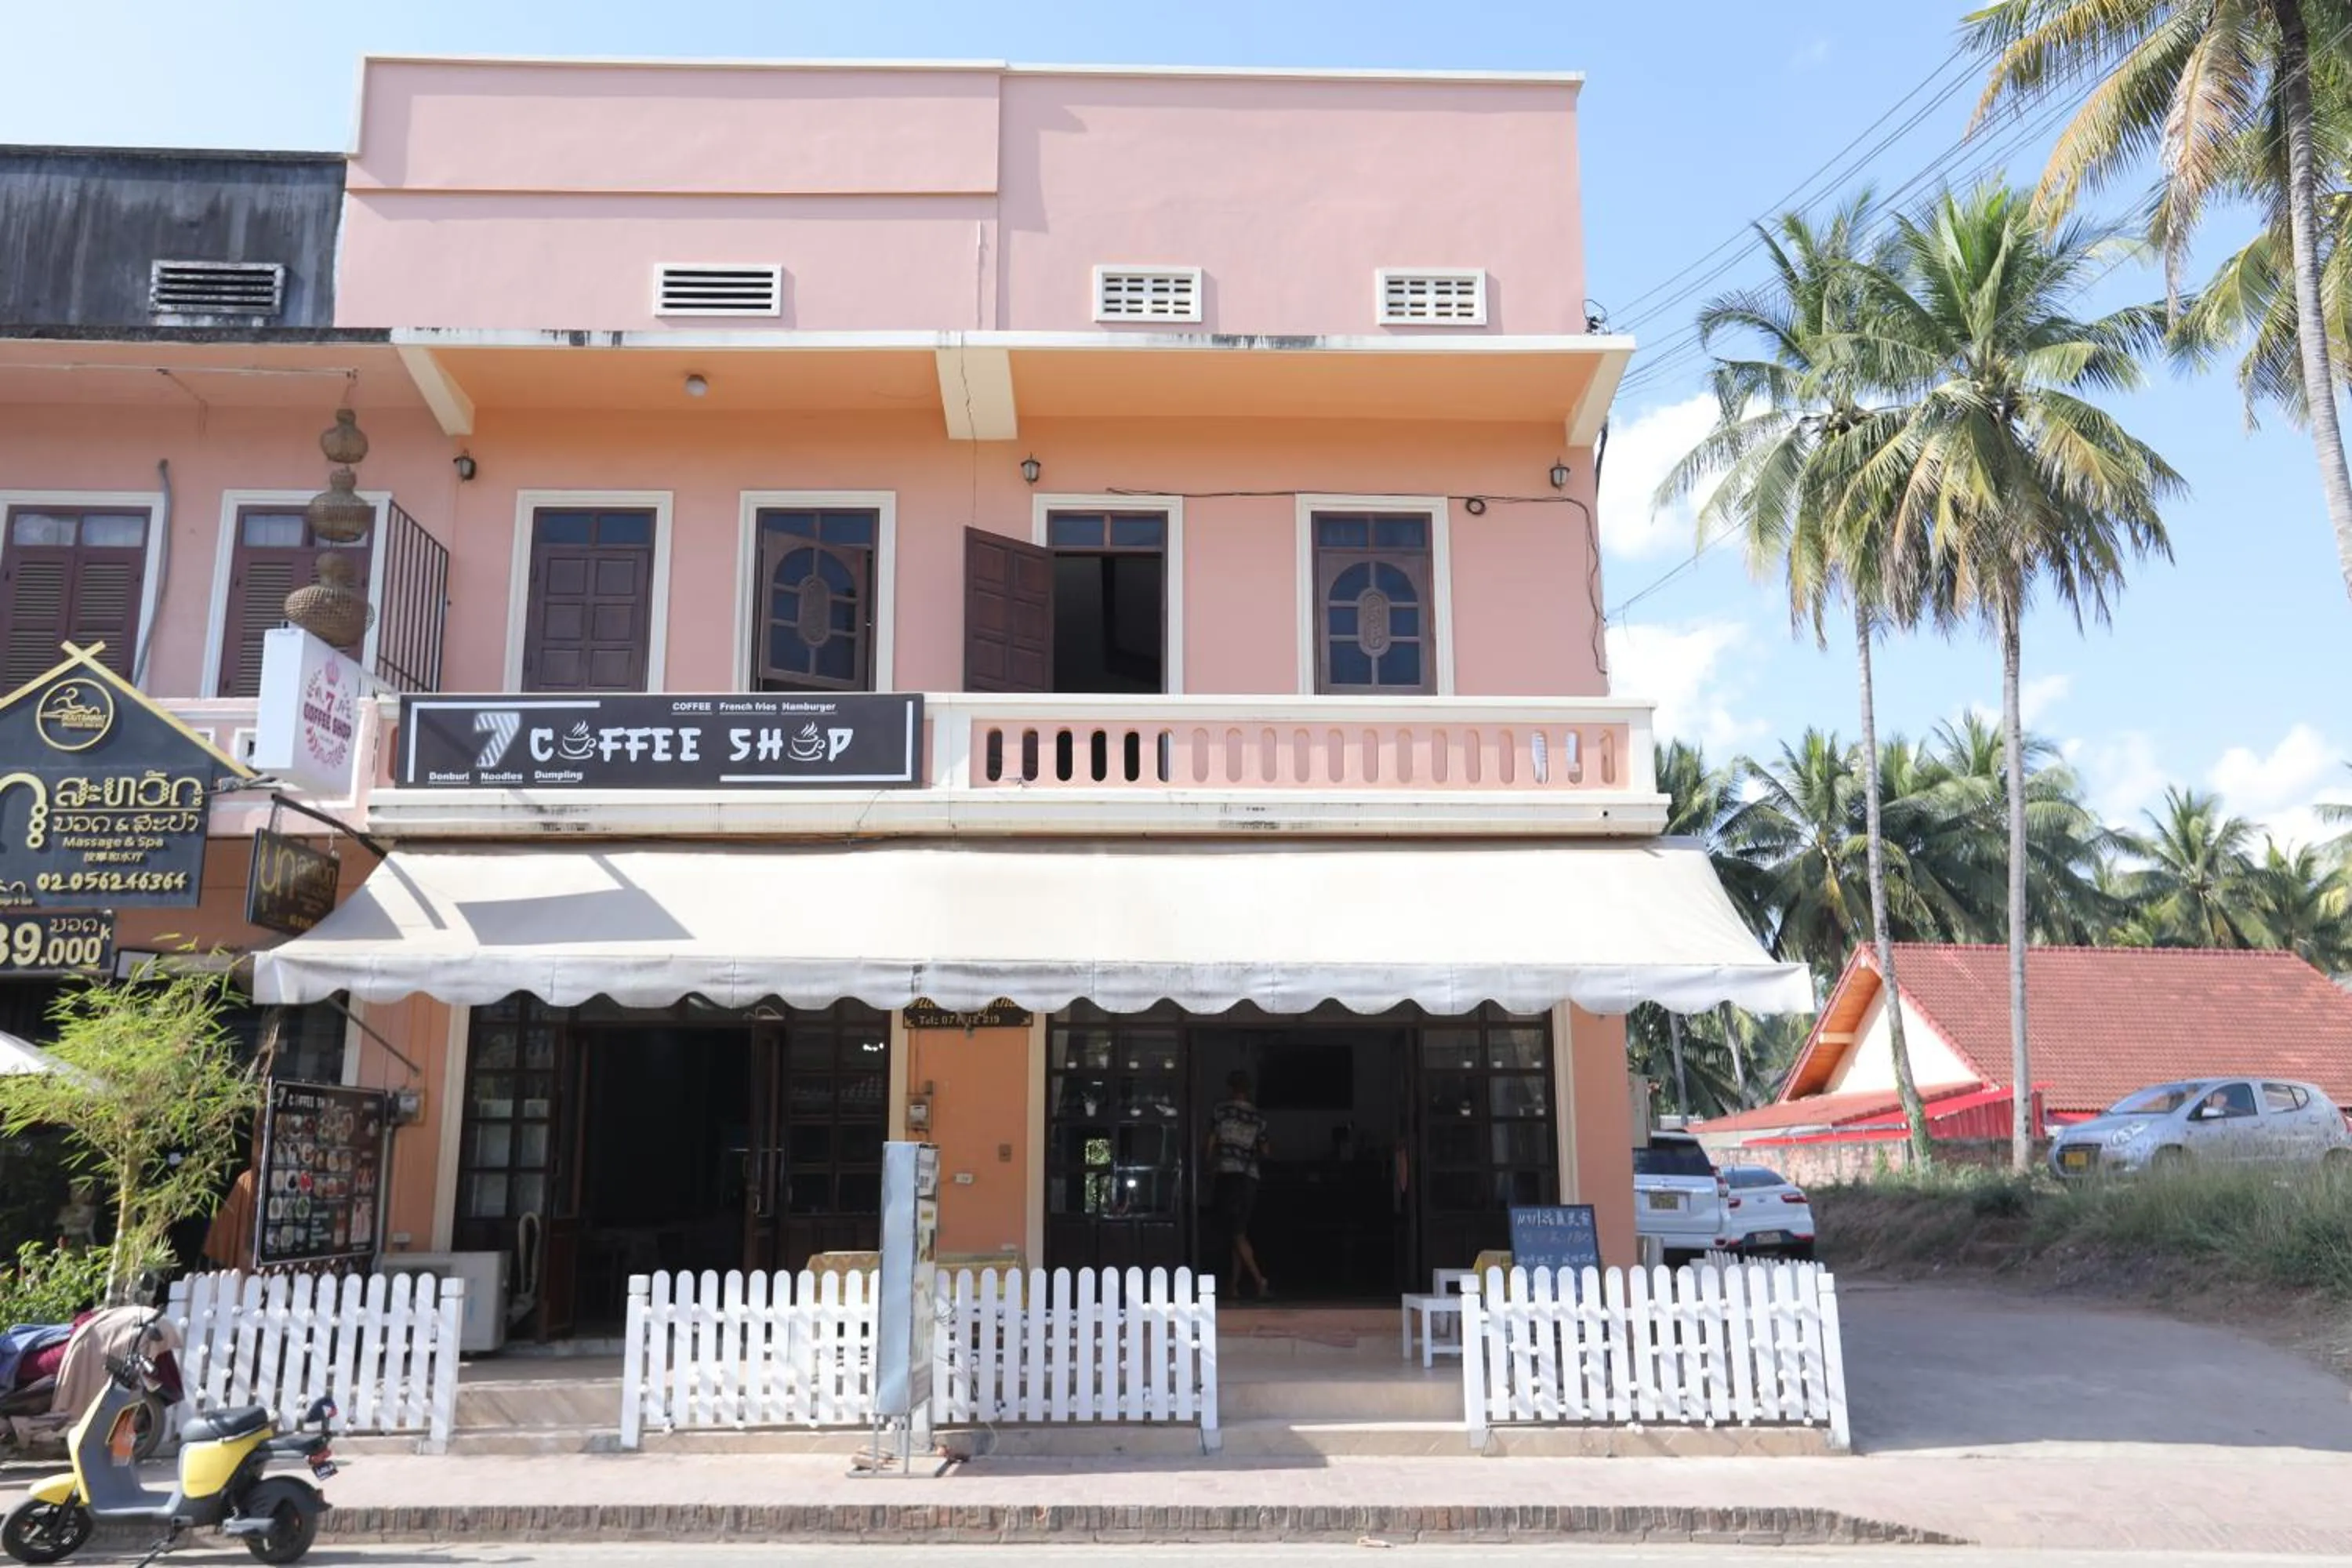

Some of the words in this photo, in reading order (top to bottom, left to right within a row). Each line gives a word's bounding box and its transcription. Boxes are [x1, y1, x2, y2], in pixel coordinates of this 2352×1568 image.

[325, 691, 336, 712] 7
[672, 702, 711, 711] COFFEE
[719, 702, 753, 711] French
[755, 702, 777, 711] fries
[781, 702, 837, 713] Hamburger
[303, 702, 331, 732] COFFEE
[332, 717, 352, 742] SHOP
[474, 711, 521, 768] 7
[428, 771, 470, 781] Donburi
[480, 772, 523, 781] Noodles
[534, 770, 583, 781] Dumpling
[114, 817, 129, 832] &
[63, 836, 122, 849] Massage
[124, 837, 135, 848] &
[137, 837, 164, 849] Spa
